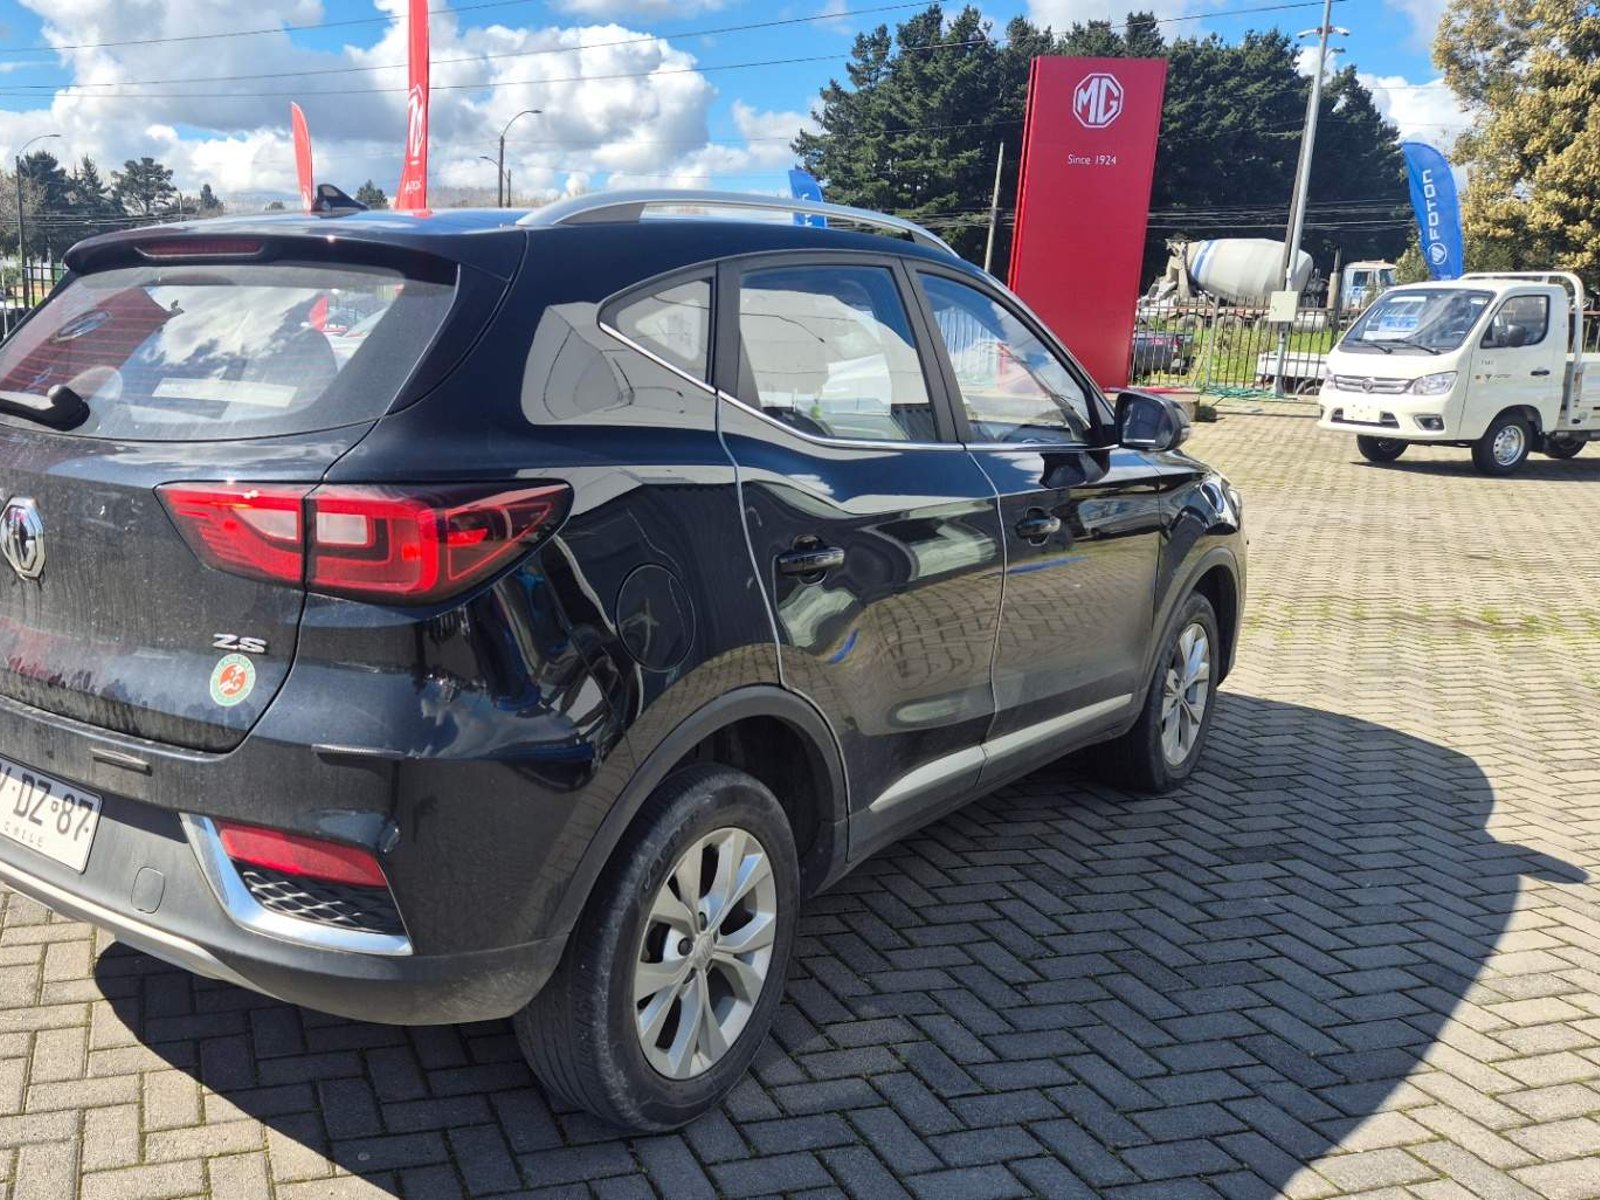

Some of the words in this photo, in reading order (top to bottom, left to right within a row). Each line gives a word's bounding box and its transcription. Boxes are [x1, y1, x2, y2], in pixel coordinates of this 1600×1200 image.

[1076, 76, 1121, 124] MG
[1067, 154, 1092, 165] Since
[1095, 155, 1117, 166] 1924
[212, 633, 267, 654] ZS
